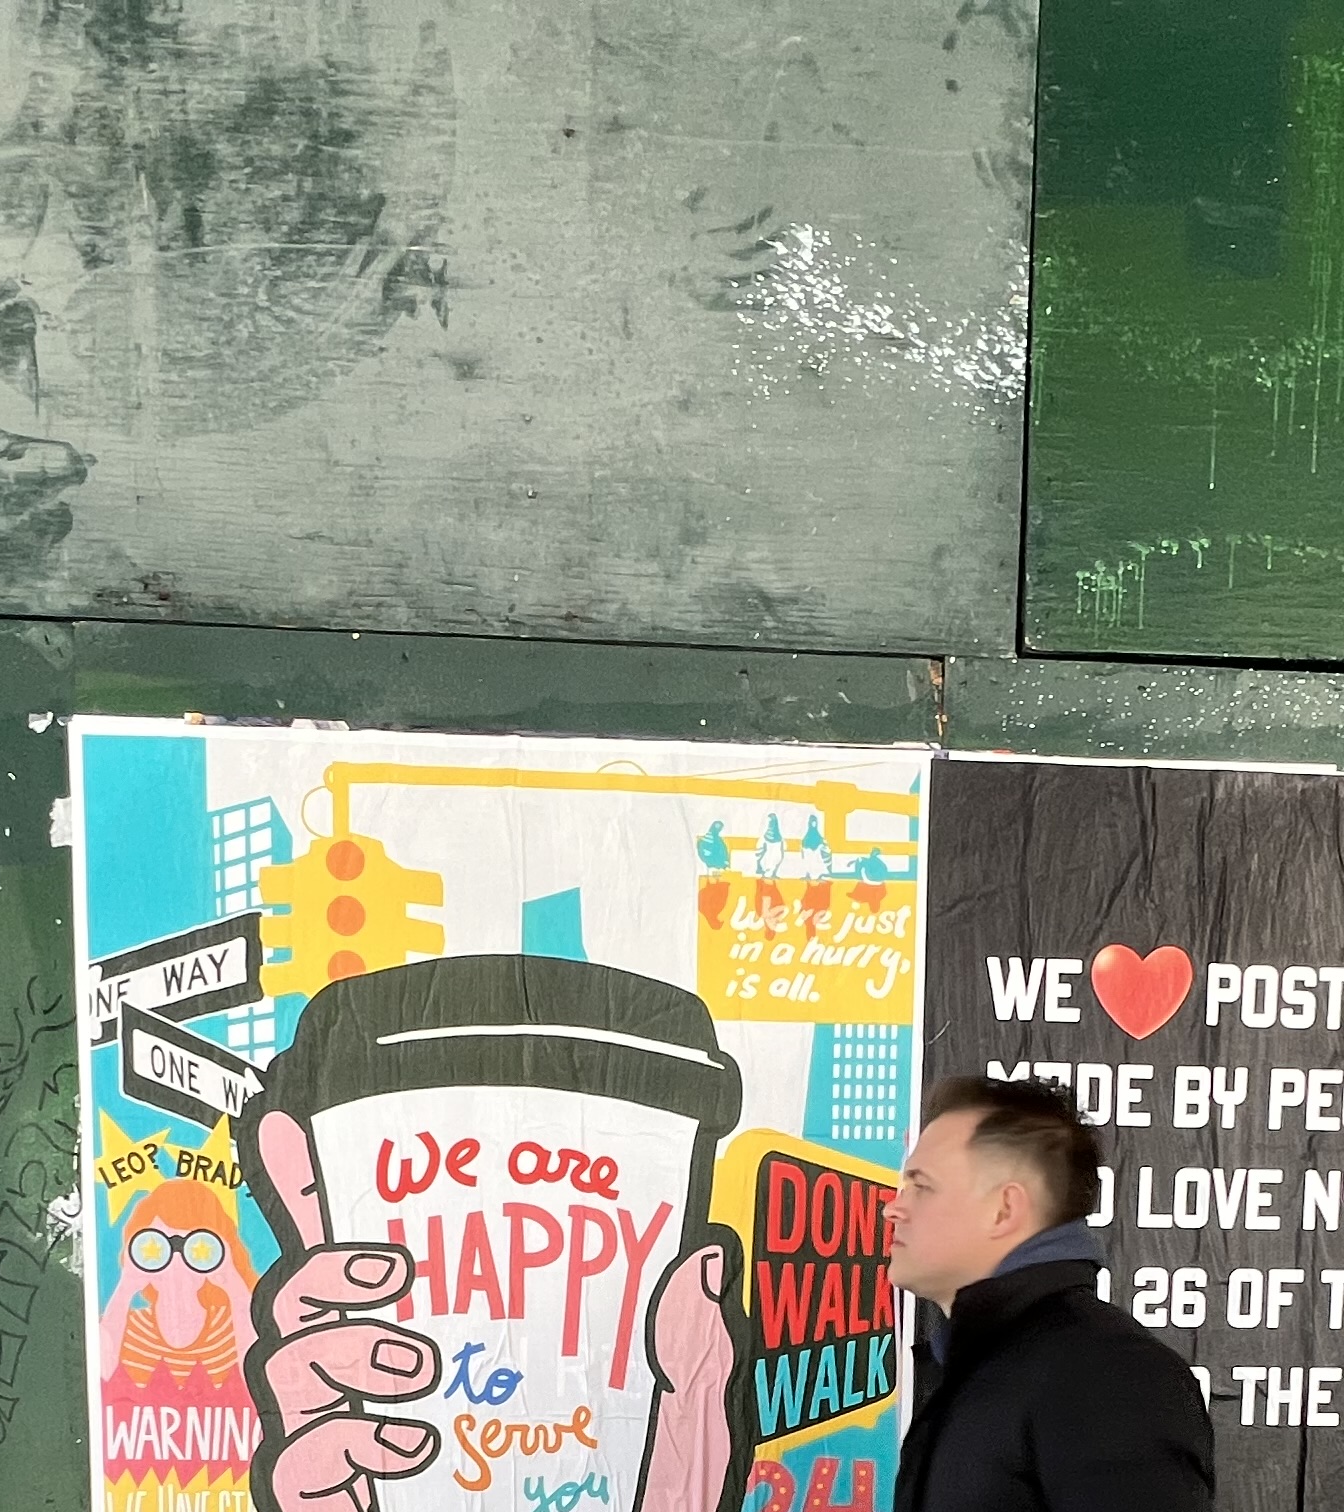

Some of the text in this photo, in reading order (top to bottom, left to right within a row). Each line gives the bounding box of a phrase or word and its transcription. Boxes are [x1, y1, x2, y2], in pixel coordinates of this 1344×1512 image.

[728, 932, 765, 962] in
[769, 942, 796, 965] a
[832, 900, 912, 943] just
[89, 948, 230, 1018] NE WAY
[725, 967, 821, 1003] is all.
[985, 955, 1084, 1023] WE
[150, 1045, 201, 1094] ONE
[1172, 1065, 1249, 1130] BY
[98, 1142, 160, 1189] LEO?
[506, 1139, 621, 1199] are
[1135, 1166, 1285, 1232] LOVE
[386, 1201, 675, 1392] HAPPY
[757, 1260, 895, 1350] WALK
[1131, 1266, 1208, 1330] 26
[1225, 1268, 1305, 1331] OF
[446, 1342, 524, 1404] to
[755, 1333, 894, 1437] WALK
[1234, 1365, 1344, 1428] THE
